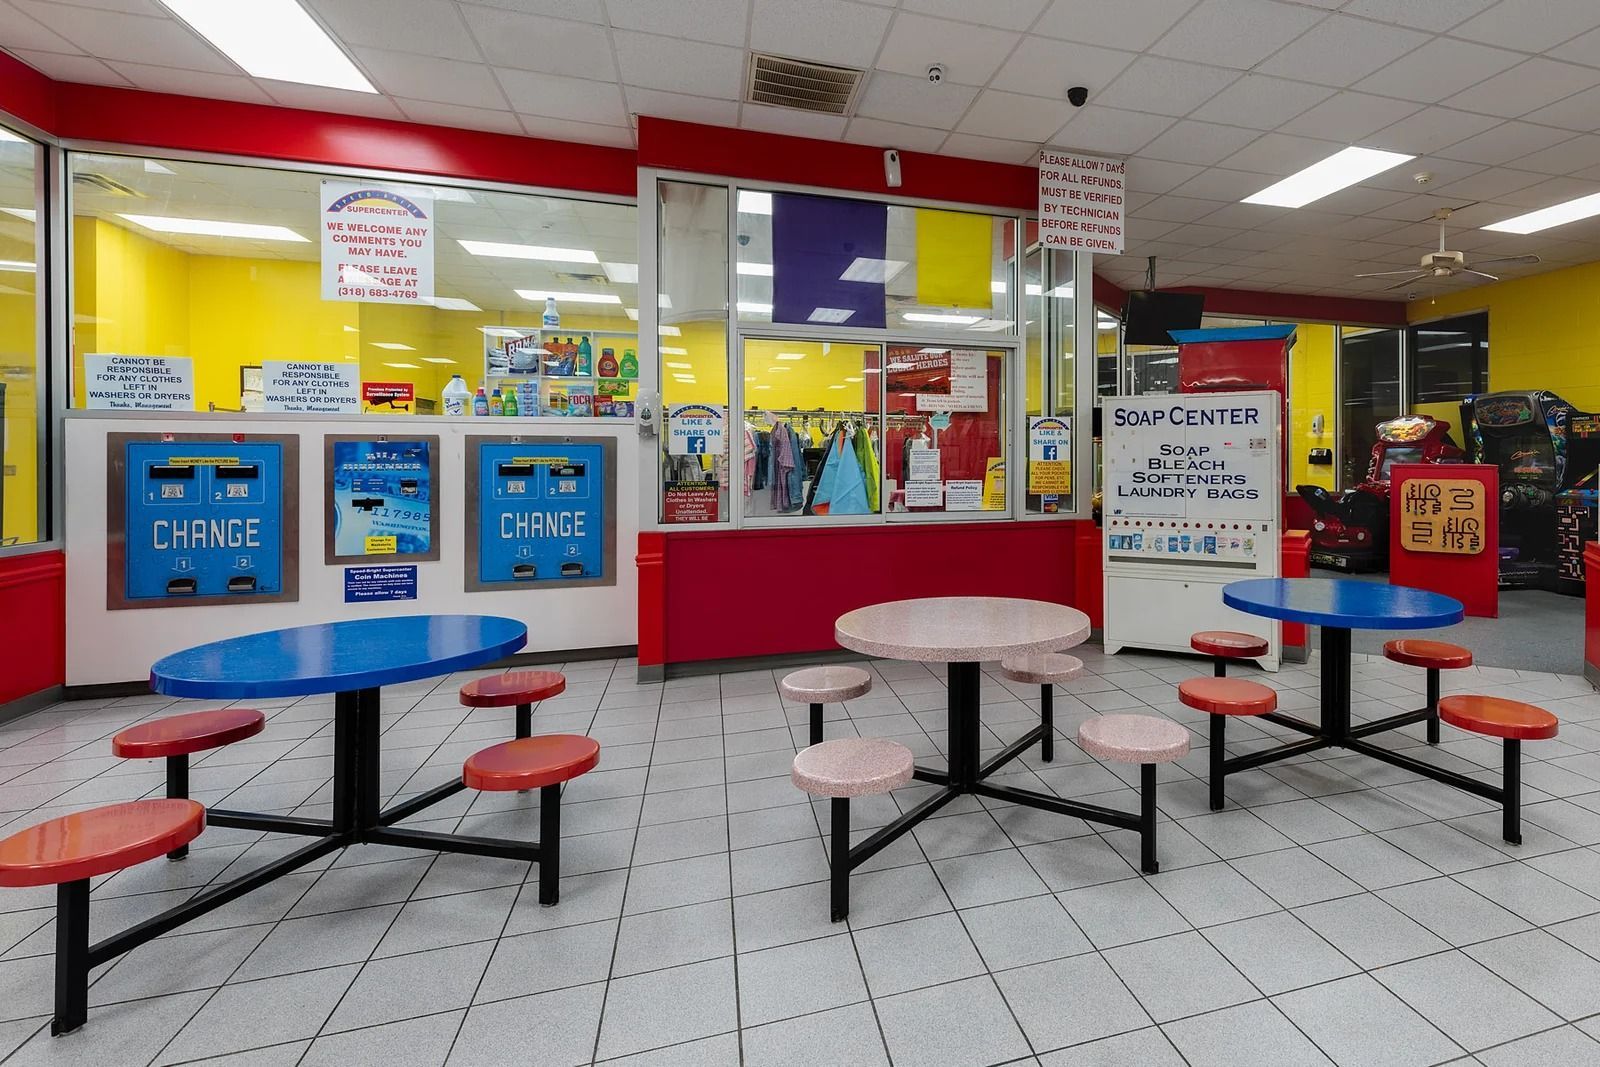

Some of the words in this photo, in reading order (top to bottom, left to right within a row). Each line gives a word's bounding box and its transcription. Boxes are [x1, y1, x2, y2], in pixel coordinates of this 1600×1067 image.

[1040, 154, 1070, 166] PLEASE
[1071, 158, 1098, 170] ALLOW
[1100, 162, 1105, 171] 7
[1106, 163, 1125, 174] DAYS
[1040, 170, 1060, 180] FOR
[1061, 173, 1079, 183] ALL
[1081, 176, 1124, 189] REFUNDS.
[1041, 187, 1067, 197] MUST
[1069, 190, 1081, 199] BE
[1083, 192, 1122, 205] VERIFIED
[346, 206, 409, 217] SUPERCENTER
[1044, 203, 1058, 213] BY
[1060, 205, 1119, 220] TECHNICIAN
[327, 222, 343, 231] WE
[347, 224, 402, 235] WELCOME
[406, 228, 428, 237] ANY
[1041, 219, 1078, 230] BEFORE
[1081, 222, 1121, 235] REFUNDS
[333, 234, 396, 246] COMMENTS
[399, 238, 422, 248] YOU
[1046, 234, 1067, 244] CAN
[1070, 236, 1083, 246] BE
[1085, 238, 1117, 250] GIVEN.
[348, 247, 372, 256] MAY
[375, 249, 407, 259] HAVE.
[383, 266, 418, 276] LEAVE
[338, 276, 344, 284] A
[404, 279, 418, 288] AT
[338, 287, 366, 298] (318)
[369, 288, 418, 299] 683-4769
[111, 357, 151, 366] CANNOT
[153, 358, 166, 366] BE
[889, 356, 902, 364] WE
[902, 353, 929, 362] SALUTE
[286, 363, 321, 371] CANNOT
[916, 358, 949, 370] HEROES
[107, 365, 172, 375] RESPONSIBLE
[139, 375, 182, 384] CLOTHES
[282, 371, 340, 380] RESPONSIBLE
[123, 383, 145, 391] LEFT
[311, 380, 350, 388] CLOTHES
[89, 391, 136, 399] WASHERS
[154, 392, 191, 401] DRYERS
[266, 395, 308, 403] WASHERS
[324, 396, 357, 404] DRYERS
[568, 395, 591, 405] FOCA
[134, 402, 172, 410] Management
[343, 463, 422, 471] DISPENSER
[149, 492, 154, 500] 1
[215, 491, 222, 500] 2
[549, 487, 556, 495] 2
[500, 511, 586, 540] CHANGE
[153, 518, 261, 550] CHANGE
[181, 560, 187, 569] 1
[240, 559, 247, 567] 2
